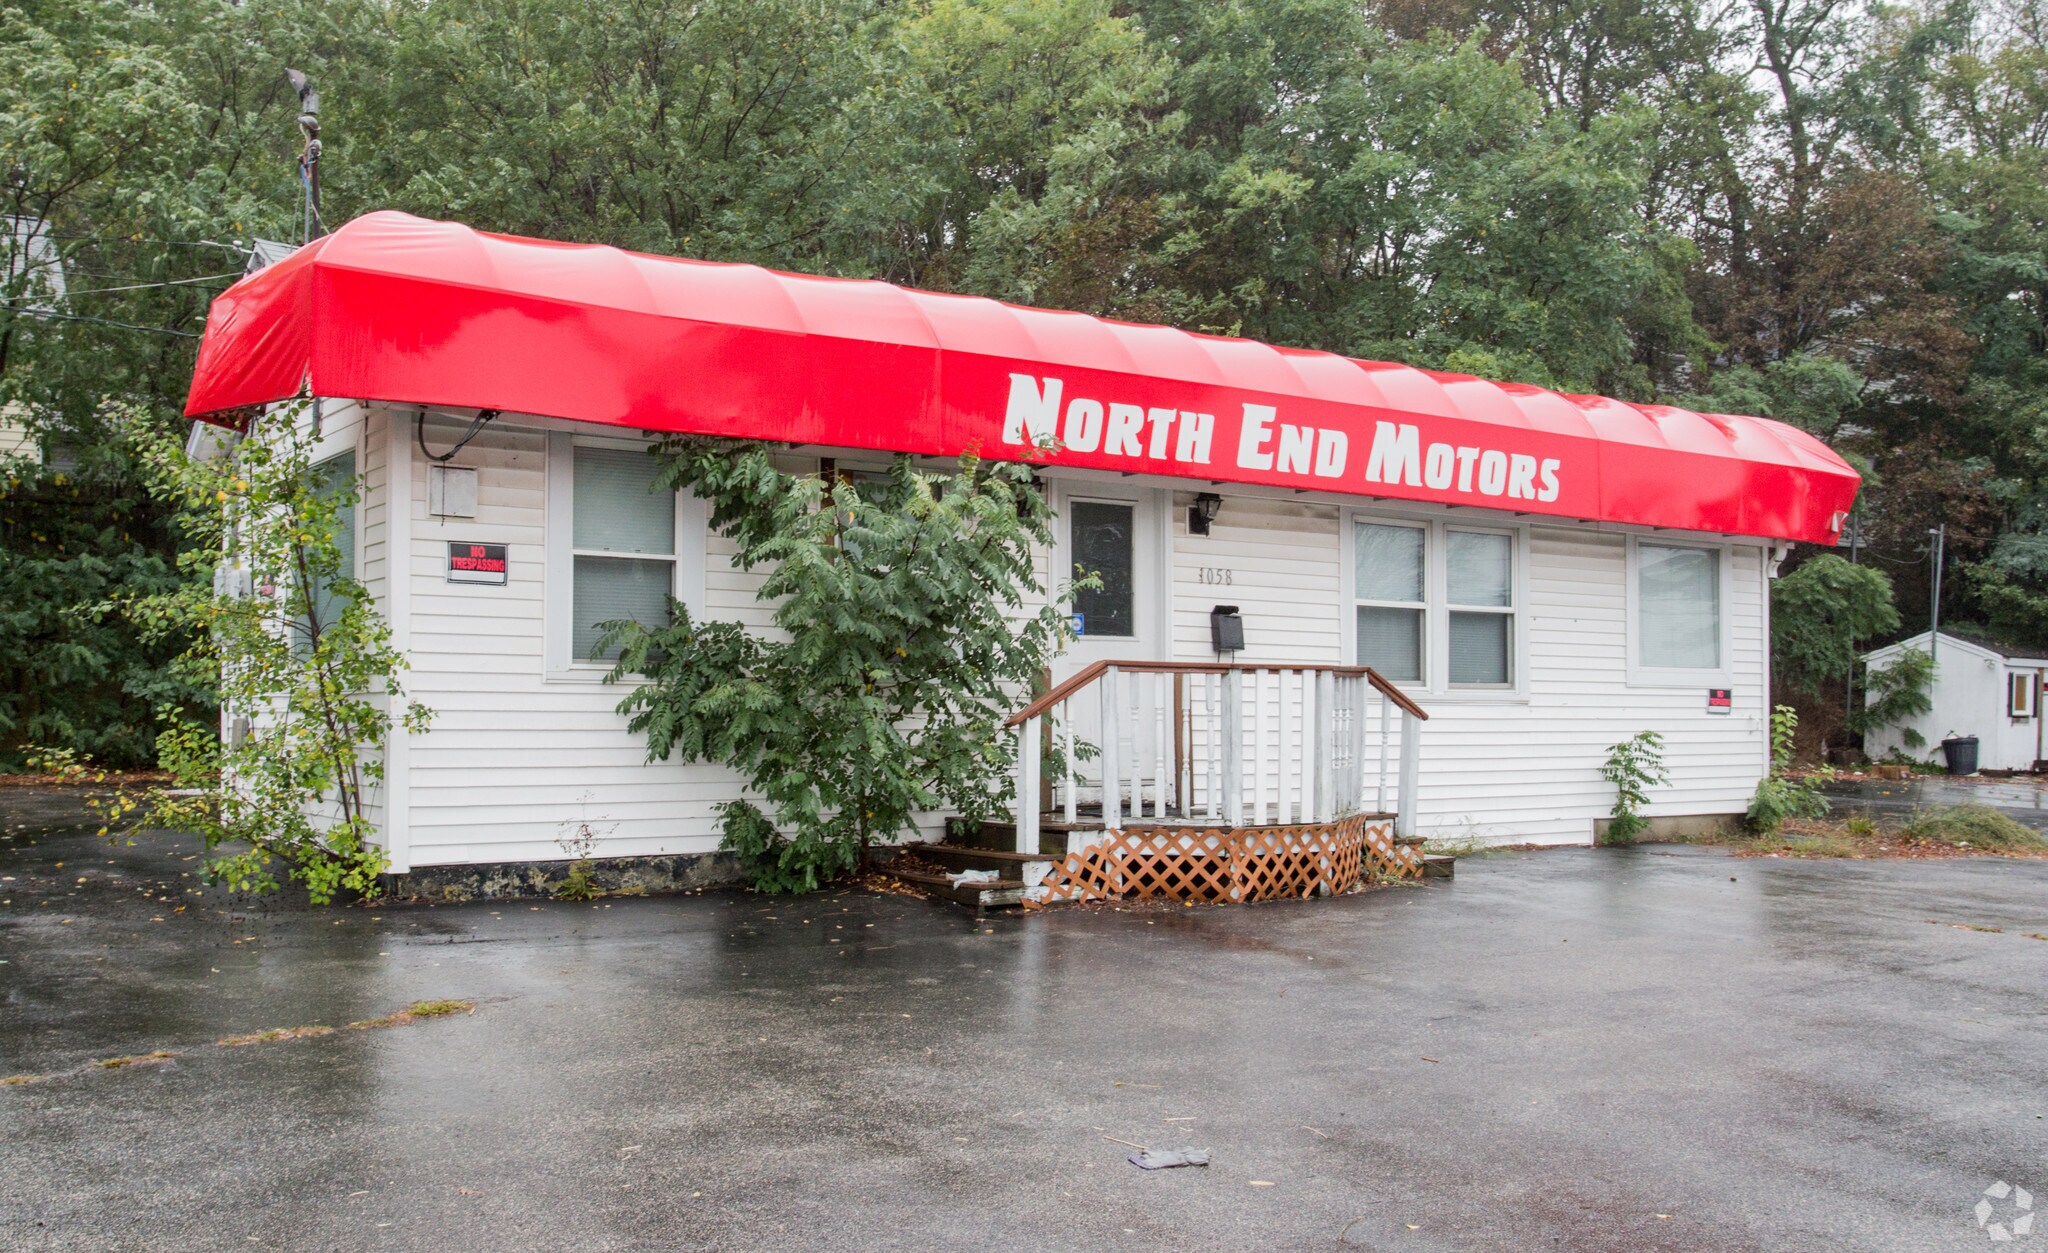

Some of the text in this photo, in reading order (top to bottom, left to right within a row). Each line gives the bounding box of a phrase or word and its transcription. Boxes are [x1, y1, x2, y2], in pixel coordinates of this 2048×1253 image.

[1003, 374, 1561, 503] NORTH END MOTORS
[470, 546, 486, 558] NO
[452, 557, 505, 572] TRESPASSING
[1199, 567, 1232, 585] 1058
